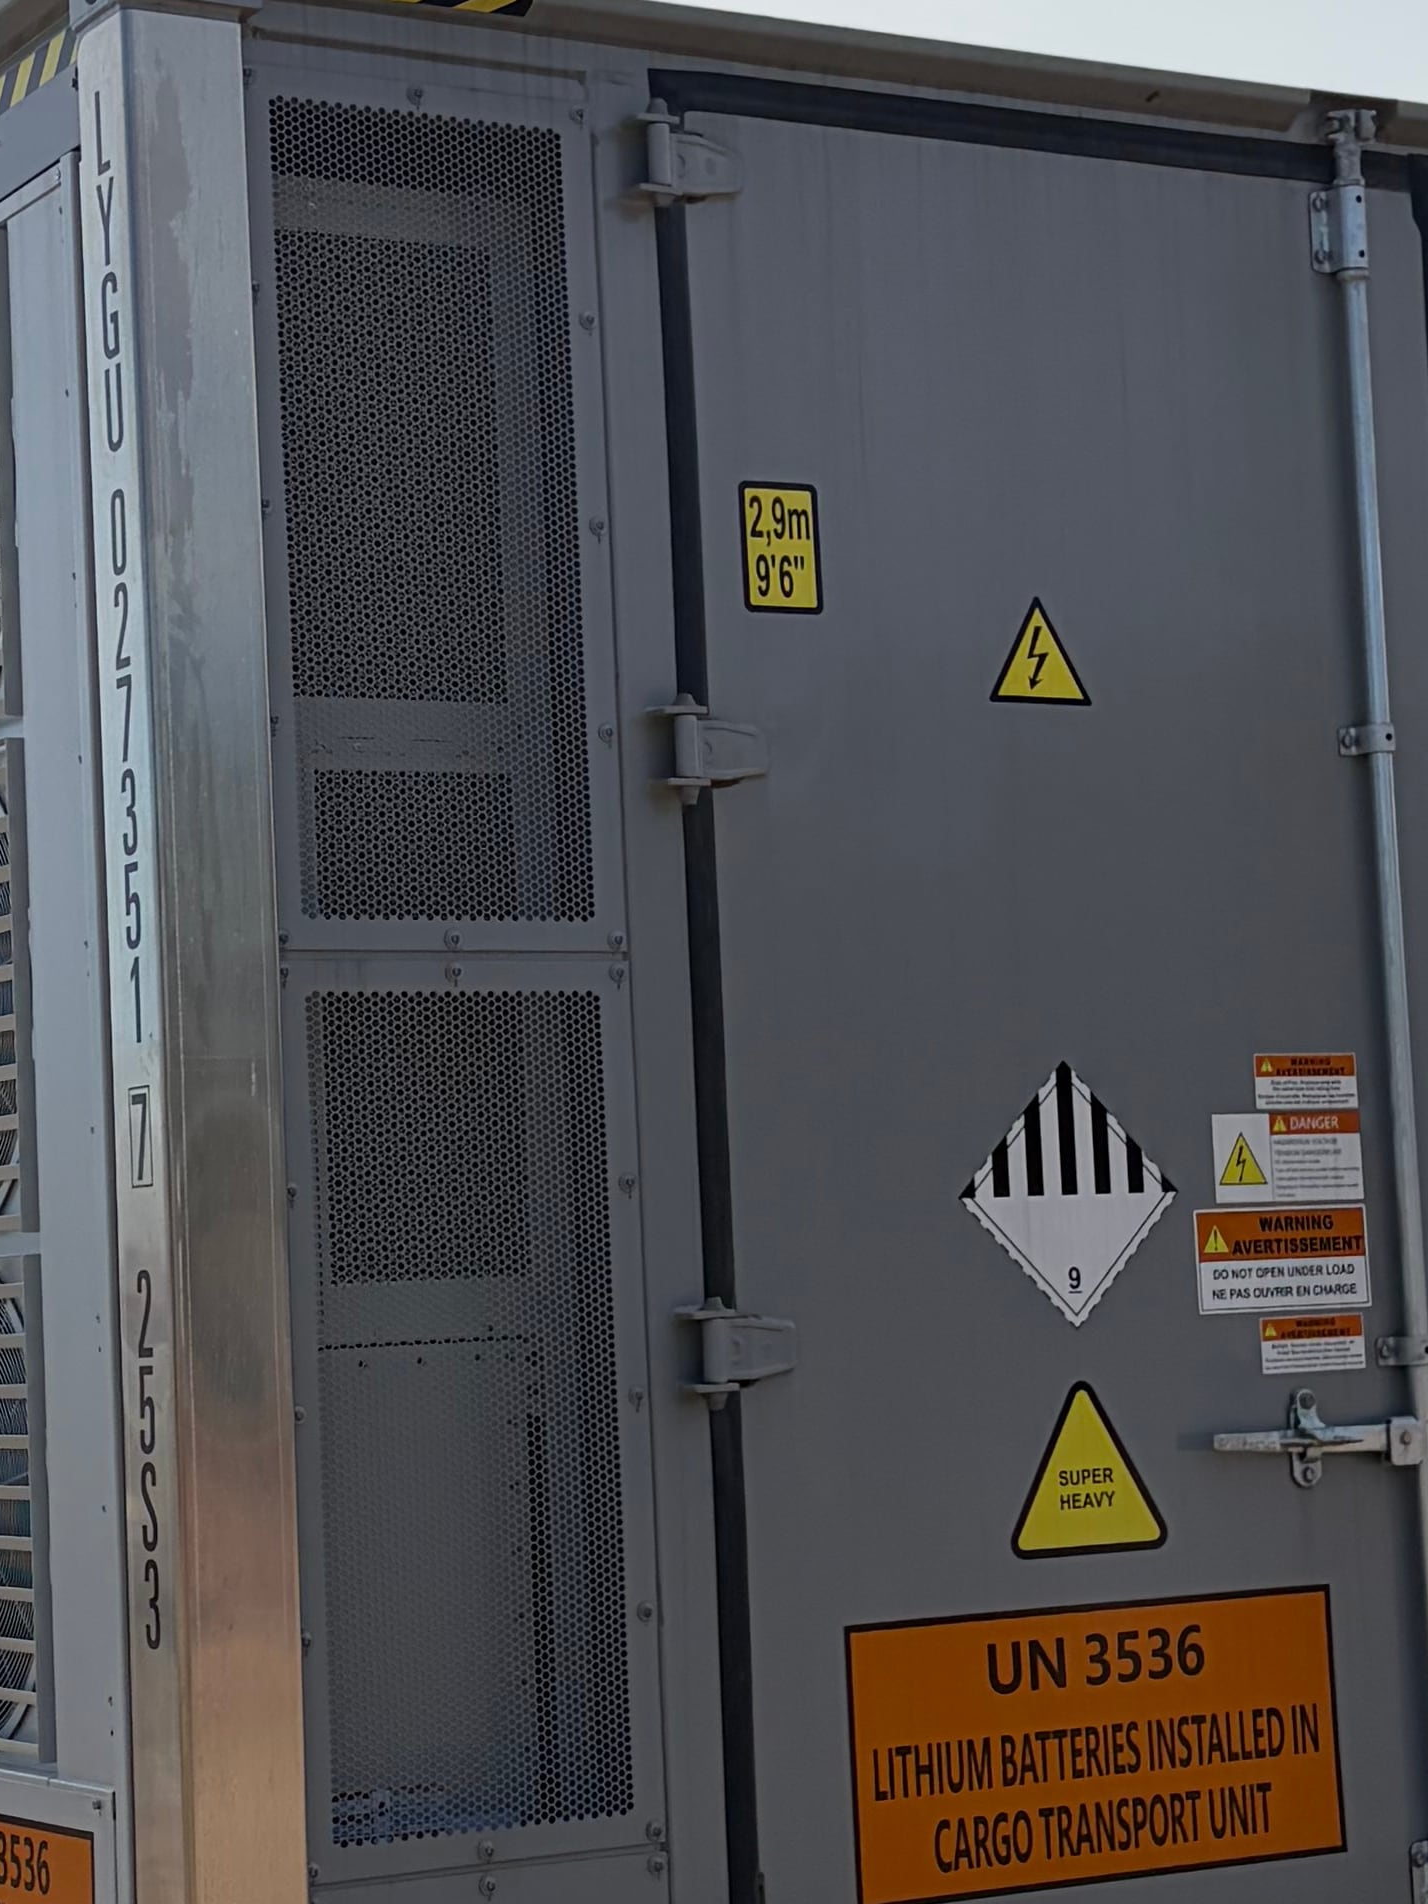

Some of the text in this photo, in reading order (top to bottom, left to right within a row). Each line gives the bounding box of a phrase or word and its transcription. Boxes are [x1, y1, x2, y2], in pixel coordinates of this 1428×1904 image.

[748, 495, 811, 547] 2,9m
[94, 90, 162, 1650] LYGU 027351 7 25S3
[1290, 1116, 1339, 1130] DANGER
[1259, 1215, 1334, 1232] WARNING
[1232, 1235, 1363, 1255] AVERTISSEMENT
[1067, 1266, 1082, 1290] 9
[1213, 1263, 1355, 1280] DO NOT OPEN UNDER LOAD
[1212, 1289, 1227, 1300] NE
[1230, 1288, 1251, 1300] PAS
[1296, 1285, 1310, 1296] EN
[1313, 1283, 1357, 1295] CHARGE
[1058, 1467, 1114, 1487] SUPER
[1059, 1491, 1115, 1510] HEAVY
[986, 1623, 1205, 1695] UN 3536
[872, 1702, 1320, 1802] LITHIUM BATTERIES INSTALLED IN
[933, 1781, 1273, 1874] CARGO TRANSPORT UNIT
